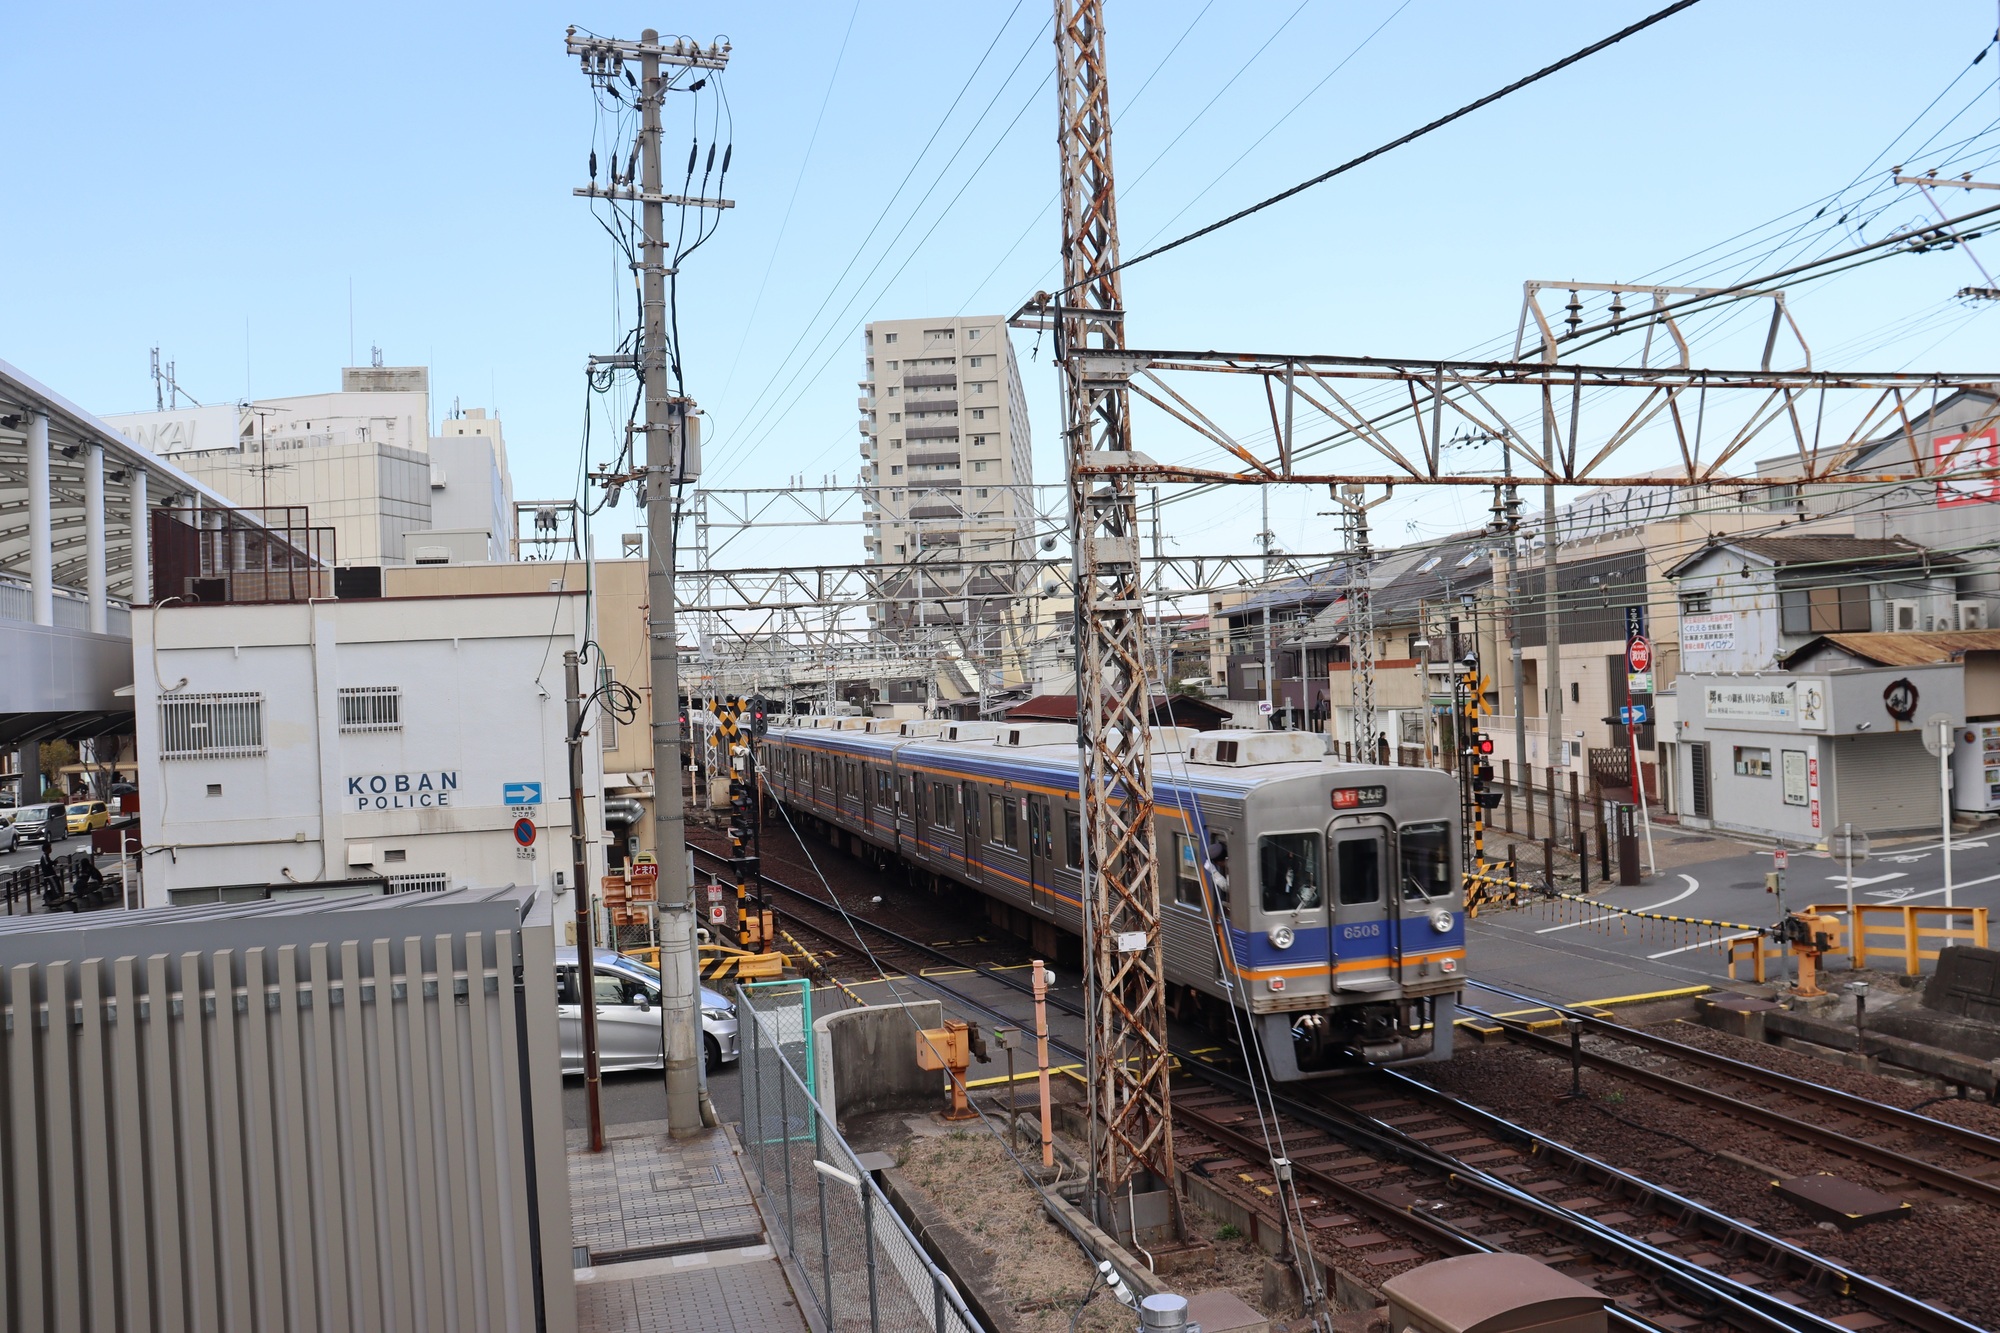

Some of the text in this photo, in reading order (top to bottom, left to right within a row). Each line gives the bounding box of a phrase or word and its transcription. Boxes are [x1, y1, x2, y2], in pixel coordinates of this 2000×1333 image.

[348, 772, 457, 795] KOBAN
[358, 793, 448, 810] POLICE
[1333, 790, 1357, 802] 急行
[634, 865, 657, 875] とまれ
[1343, 924, 1380, 939] 6508
